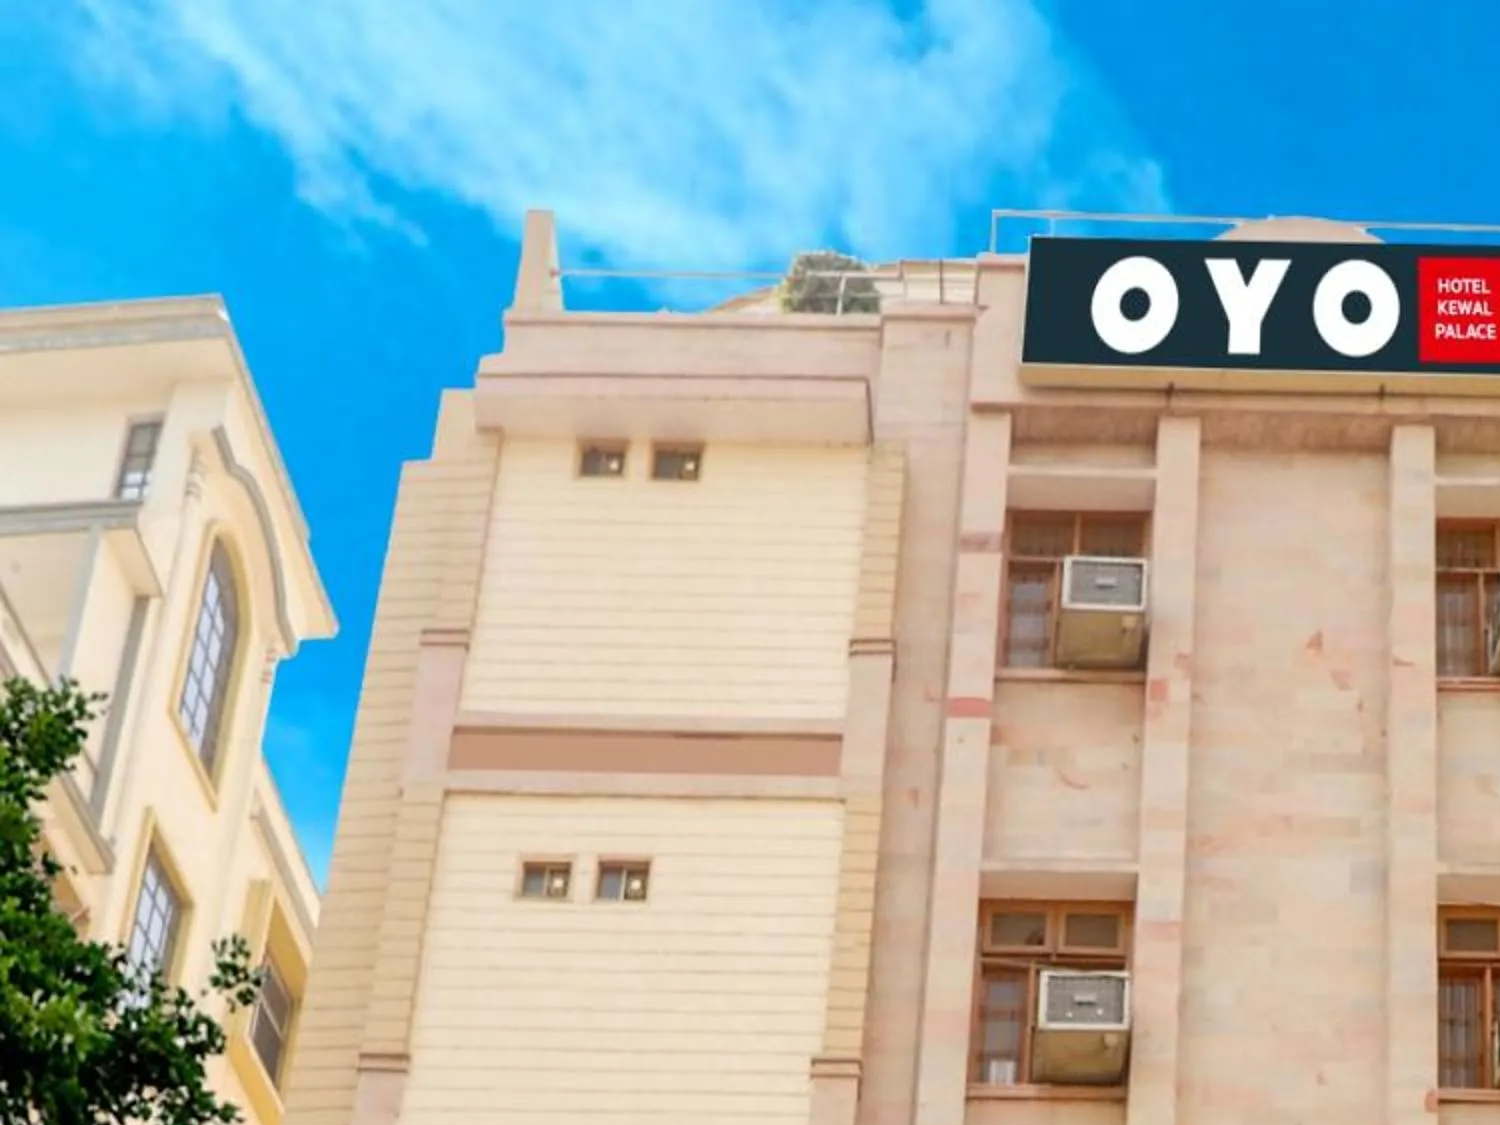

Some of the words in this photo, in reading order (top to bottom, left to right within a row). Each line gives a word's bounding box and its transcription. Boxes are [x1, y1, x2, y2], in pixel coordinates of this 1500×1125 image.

[1437, 277, 1492, 294] HOTEL
[1091, 255, 1400, 357] OYO
[1437, 299, 1495, 316] KEWAL
[1434, 322, 1498, 339] PALACE
